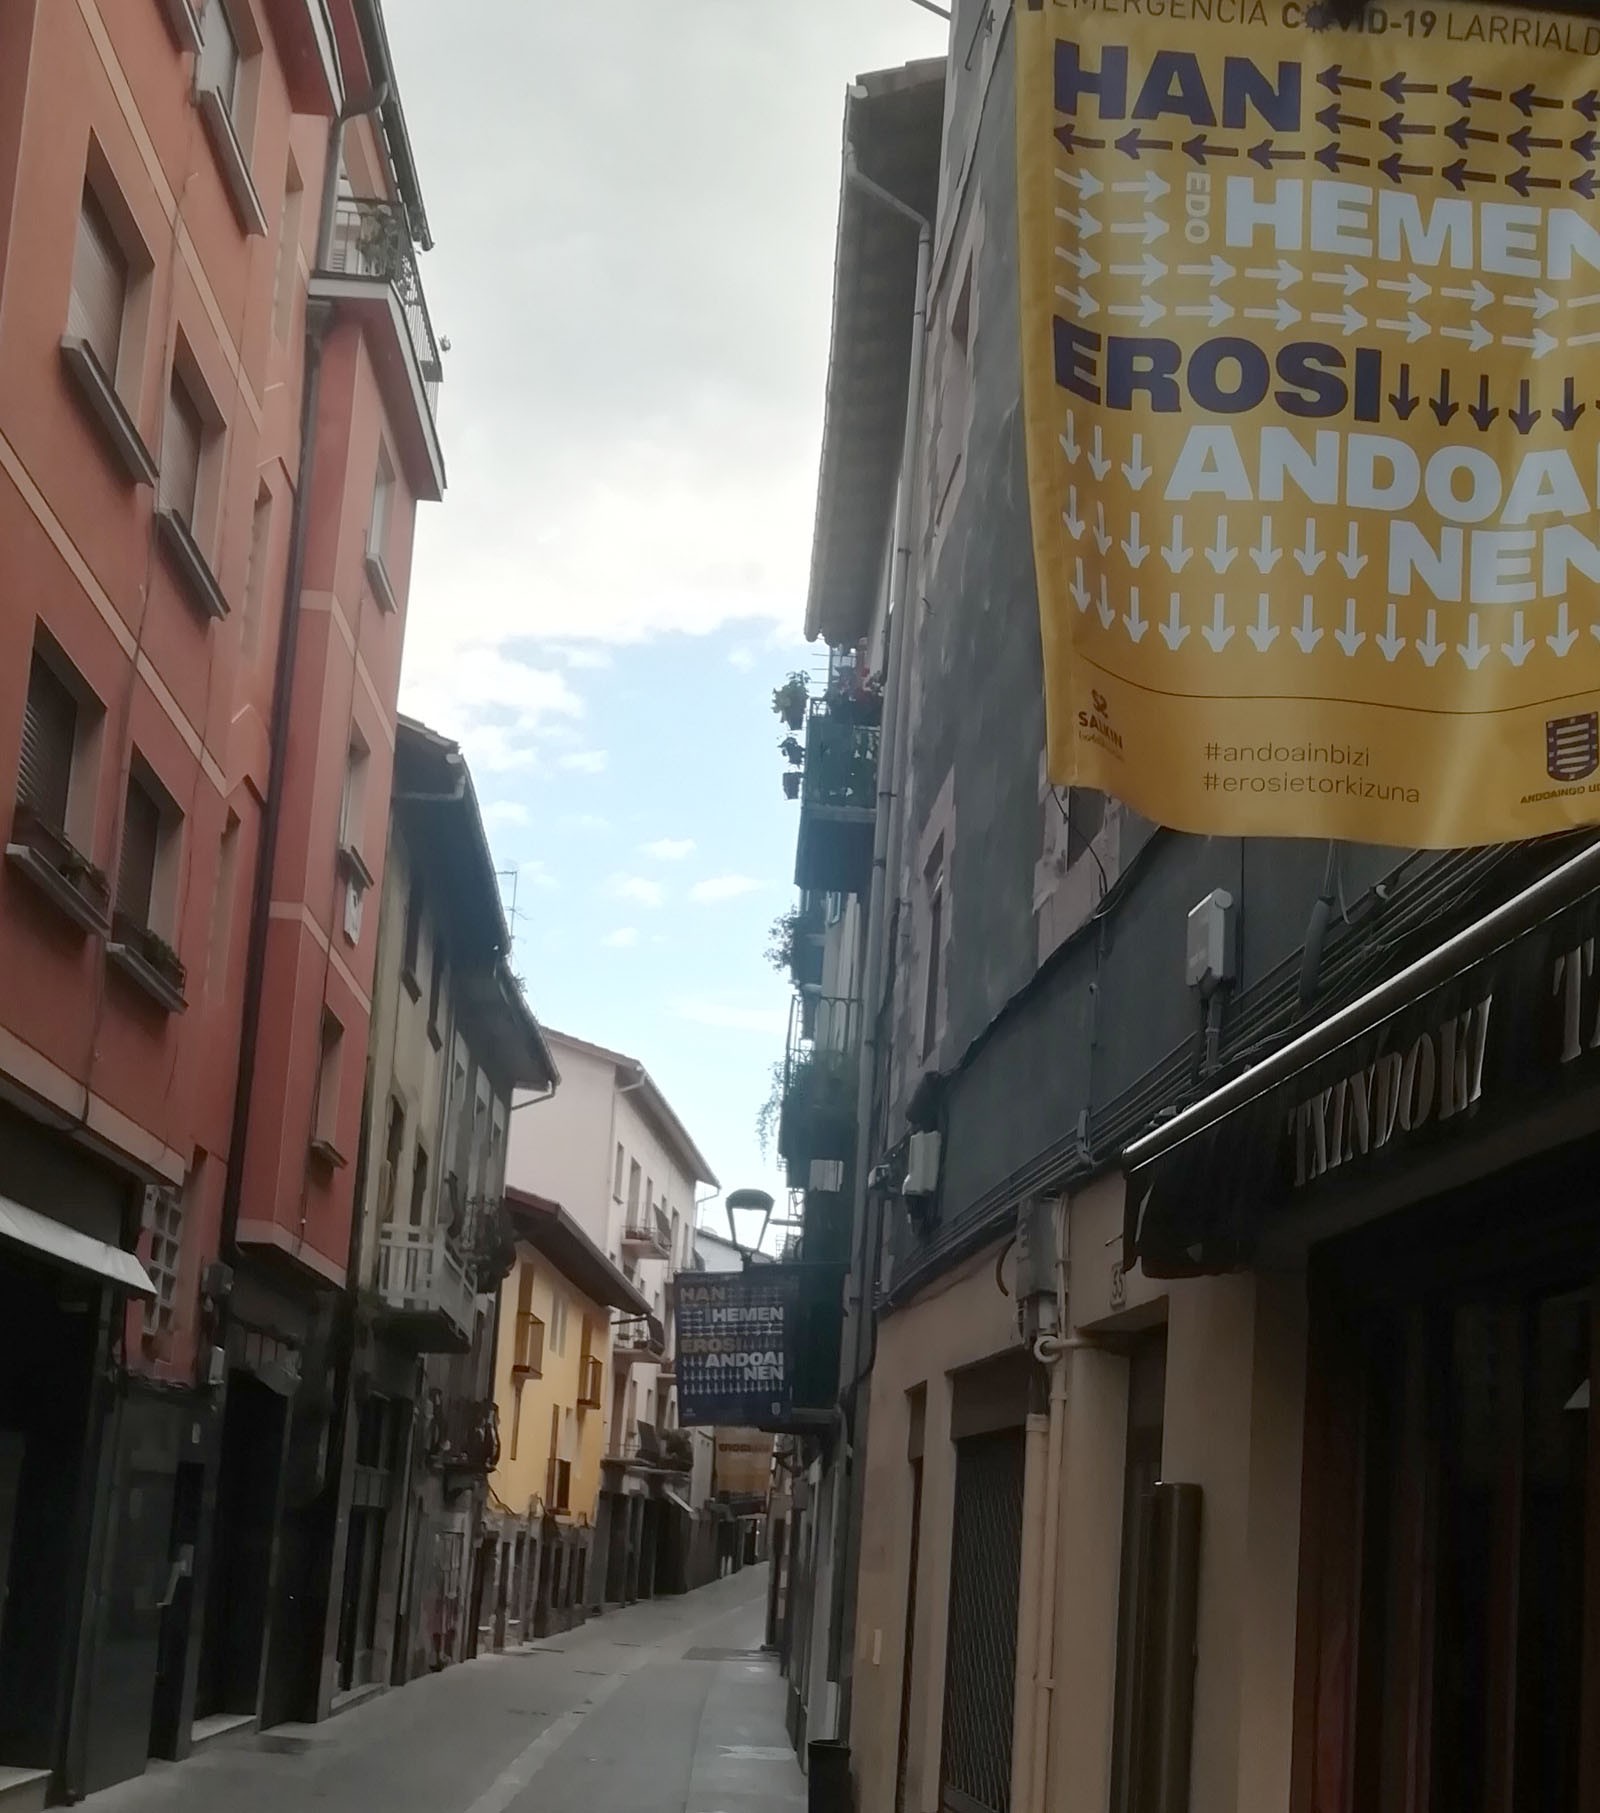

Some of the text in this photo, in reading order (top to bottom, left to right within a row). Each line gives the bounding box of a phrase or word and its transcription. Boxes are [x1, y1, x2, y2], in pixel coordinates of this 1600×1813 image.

[1446, 12, 1600, 56] LARRIALD
[1054, 38, 1302, 132] HAN
[1184, 171, 1211, 244] EDO
[1225, 175, 1600, 281] HEMEN
[1052, 314, 1382, 423] EROSI
[1163, 425, 1600, 524] ANDOA
[1387, 519, 1600, 604] NEN
[1203, 742, 1370, 767] #andoainbizi
[1202, 771, 1420, 803] #erosietorkizuna
[1520, 785, 1586, 804] ANDOAINGO
[680, 1287, 726, 1302] HAN
[712, 1306, 784, 1323] HEMEN
[680, 1337, 742, 1353] EROSI
[705, 1351, 784, 1368] ANDOAI
[743, 1366, 784, 1381] NEN
